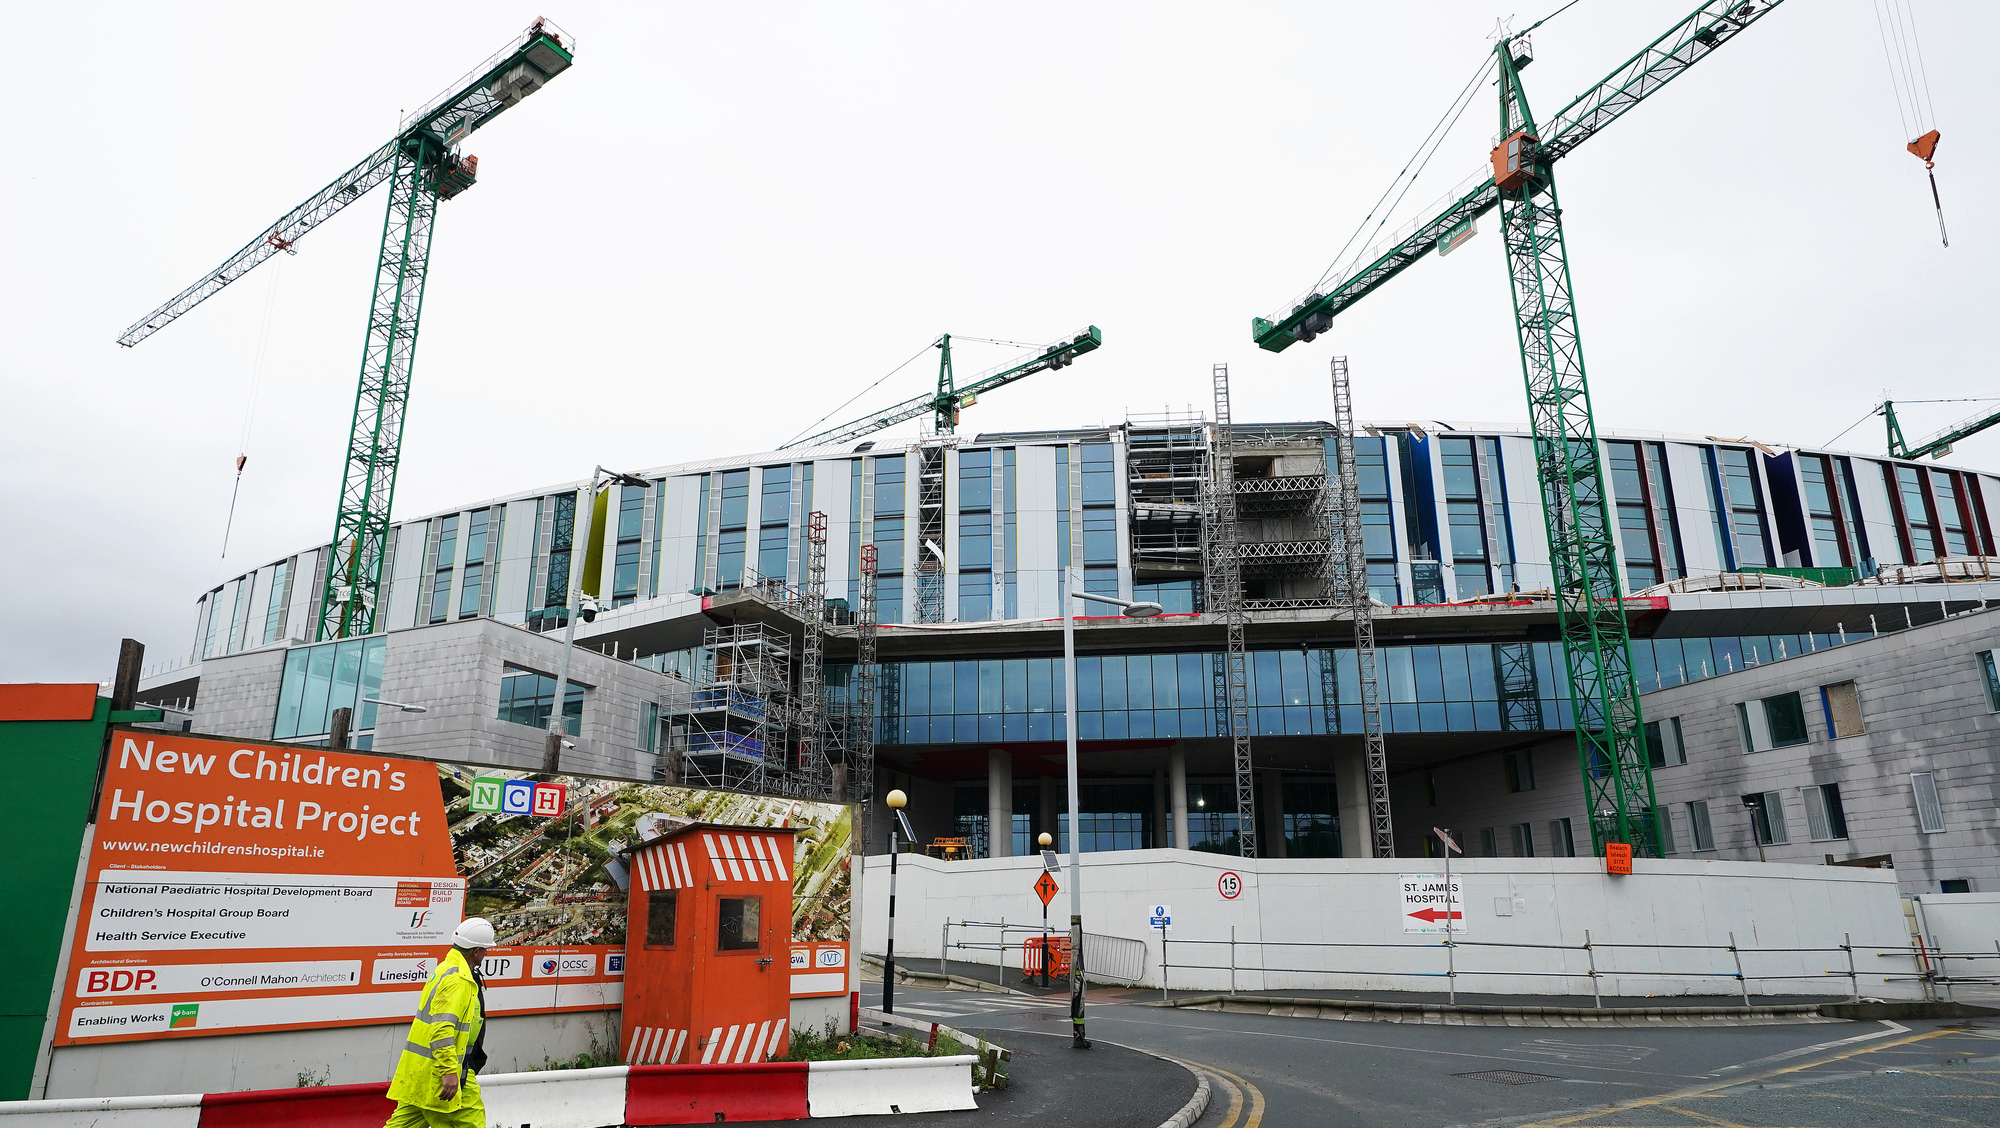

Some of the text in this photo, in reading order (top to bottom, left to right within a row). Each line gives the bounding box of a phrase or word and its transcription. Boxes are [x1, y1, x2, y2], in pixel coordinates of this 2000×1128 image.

[1451, 224, 1467, 238] bam
[119, 738, 406, 791] New Children’s
[475, 785, 557, 811] NCH
[109, 788, 421, 841] Hospital Project
[102, 840, 325, 859] www.newchildrenshospital.ie
[1222, 878, 1237, 890] 15
[1404, 883, 1459, 892] ST. JAMES
[104, 884, 373, 898] National Paediatric Hospital Development Board
[100, 908, 290, 919] Children’s Hospital Group Board
[95, 930, 247, 941] Health Service Executive
[562, 960, 588, 969] OCSC
[791, 956, 804, 964] GVA
[823, 953, 838, 963] IVT
[480, 958, 510, 977] UP
[87, 969, 157, 993] BDP.
[200, 972, 347, 987] O’Connell Mahon Architects
[380, 970, 428, 981] Linesight
[77, 1014, 165, 1026] Enabling Works
